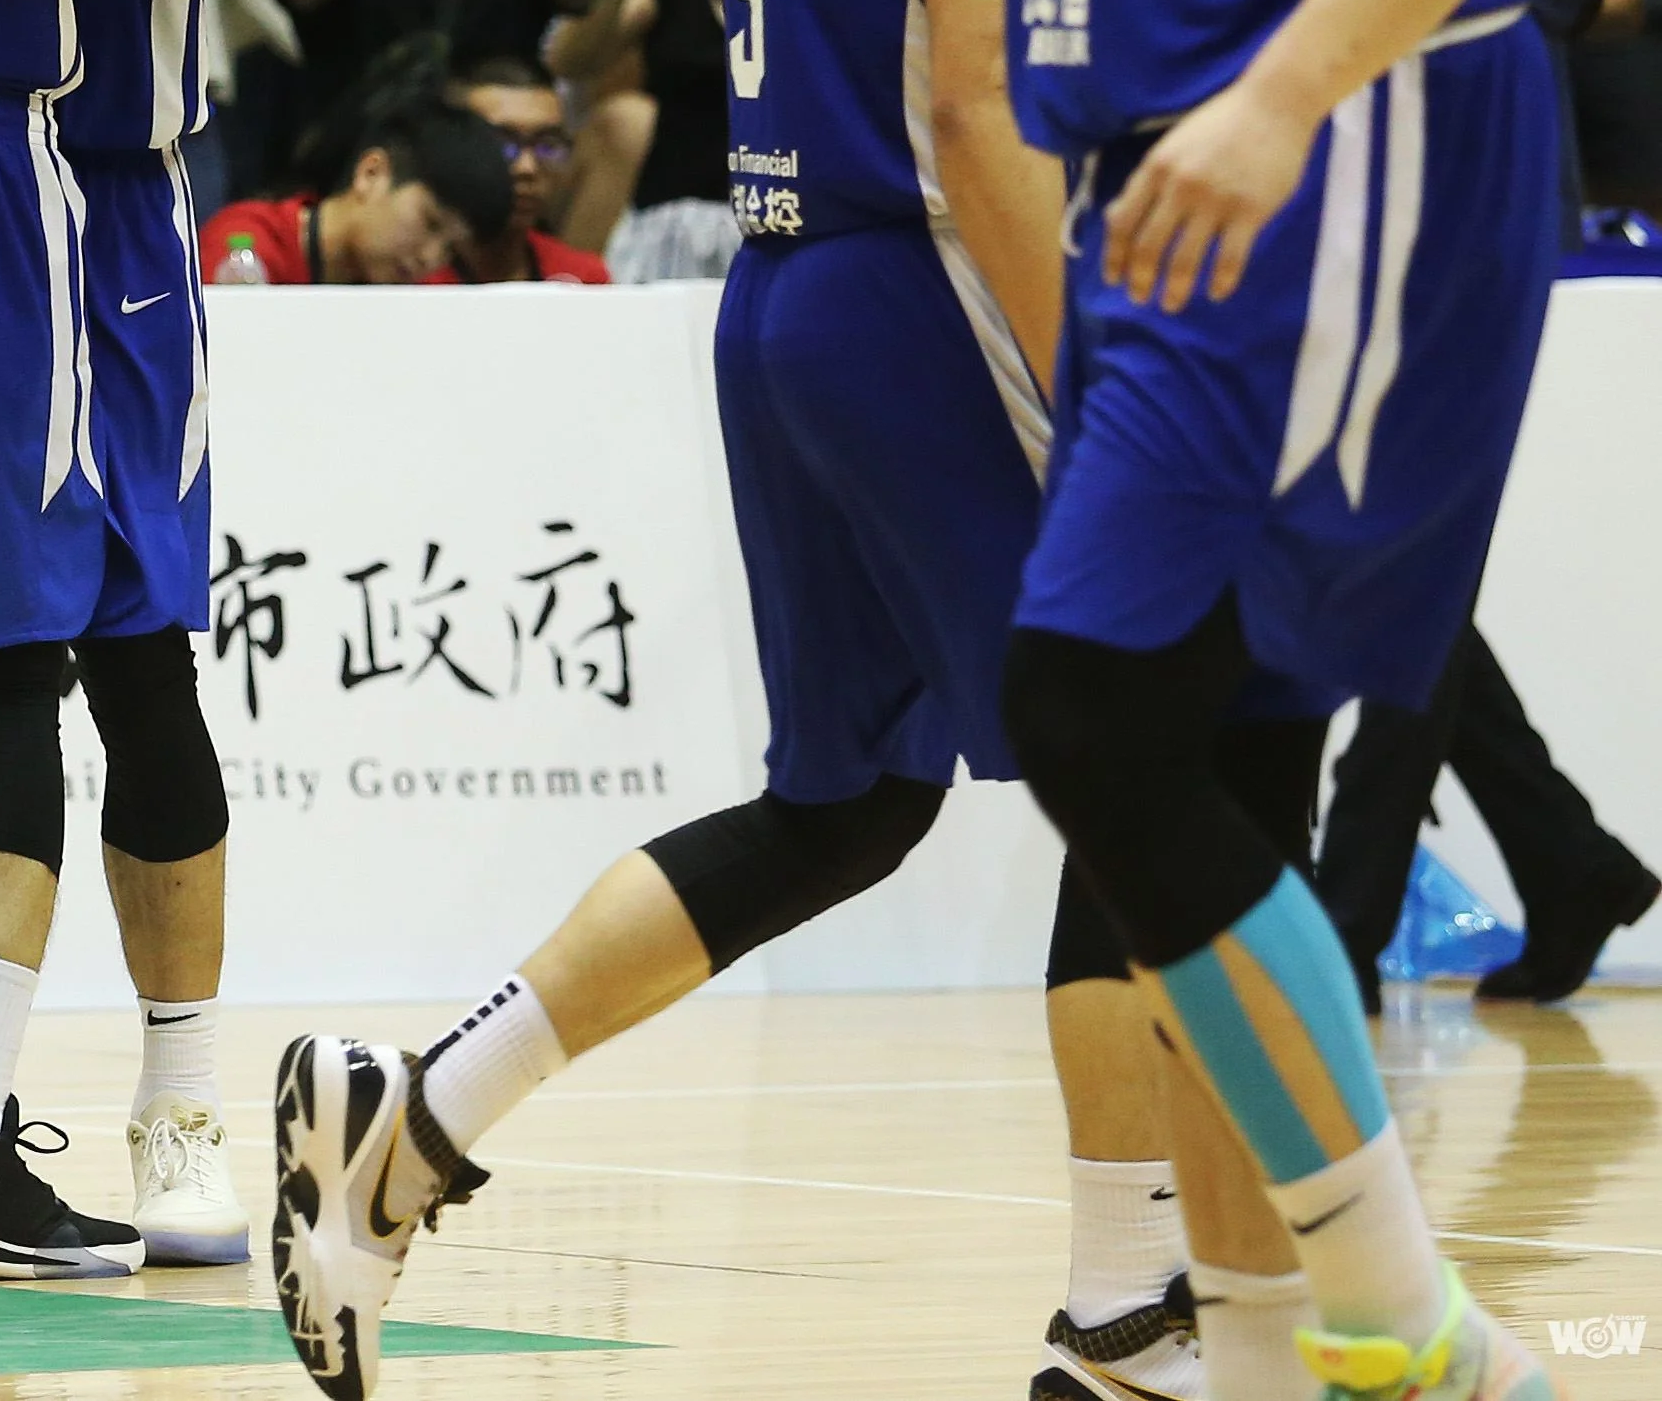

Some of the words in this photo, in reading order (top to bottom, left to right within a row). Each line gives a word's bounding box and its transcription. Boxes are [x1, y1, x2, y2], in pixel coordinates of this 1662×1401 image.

[210, 522, 635, 722] 市政府
[348, 756, 668, 799] Government
